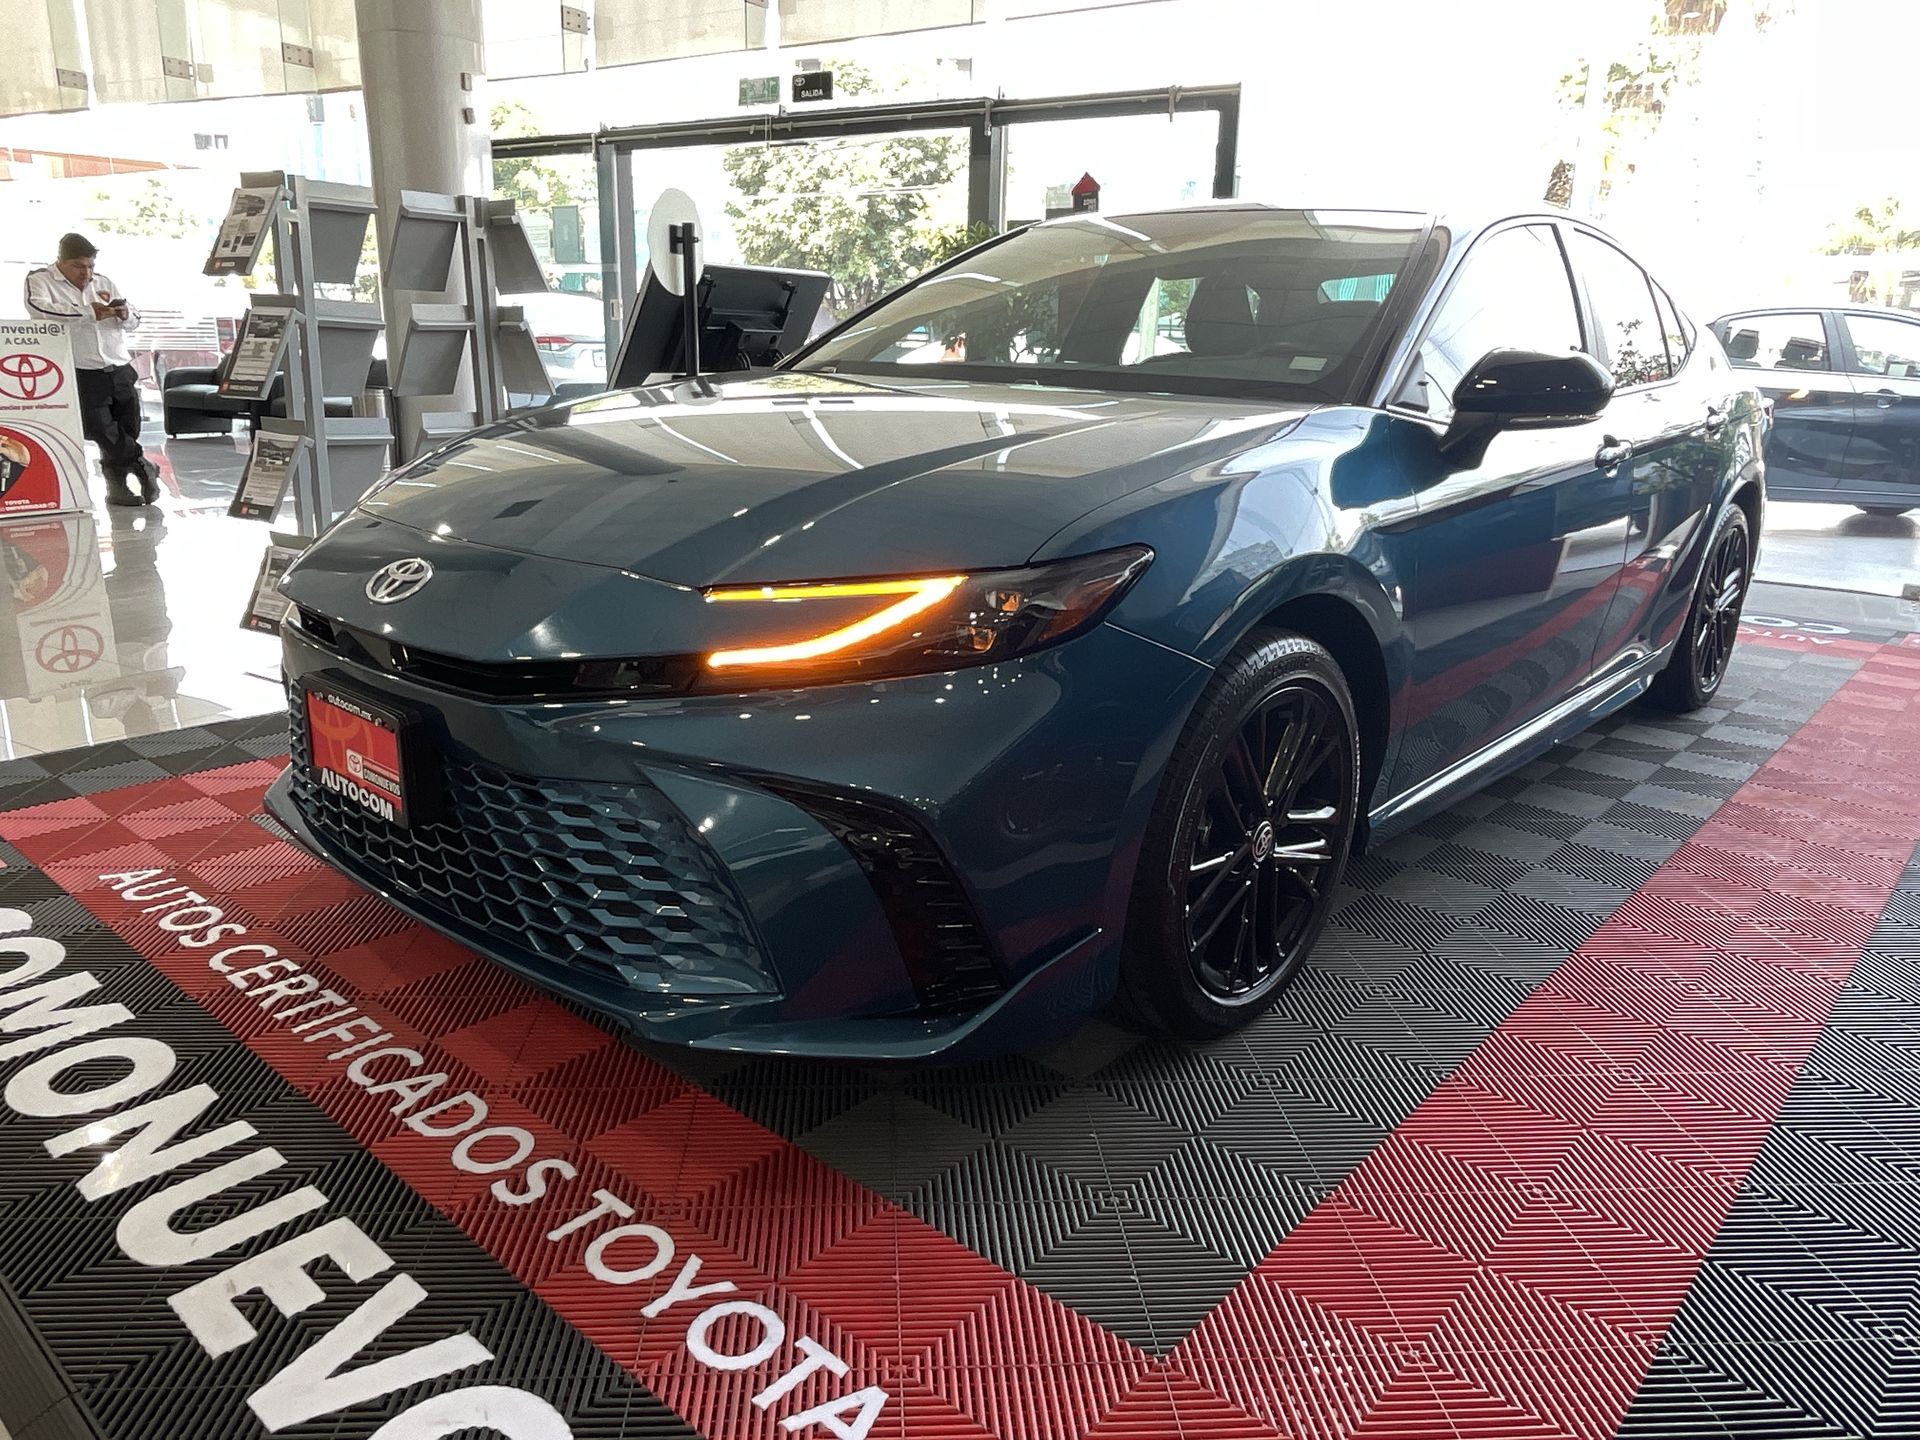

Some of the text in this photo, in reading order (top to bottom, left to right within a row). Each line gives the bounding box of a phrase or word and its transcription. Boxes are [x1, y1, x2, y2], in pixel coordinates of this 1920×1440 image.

[801, 89, 823, 98] SALIDA
[321, 767, 394, 822] AUTOCOM
[0, 907, 575, 1440] MONUEV
[98, 868, 889, 1440] AUTOS CERTIFICADOS TOYOTA
